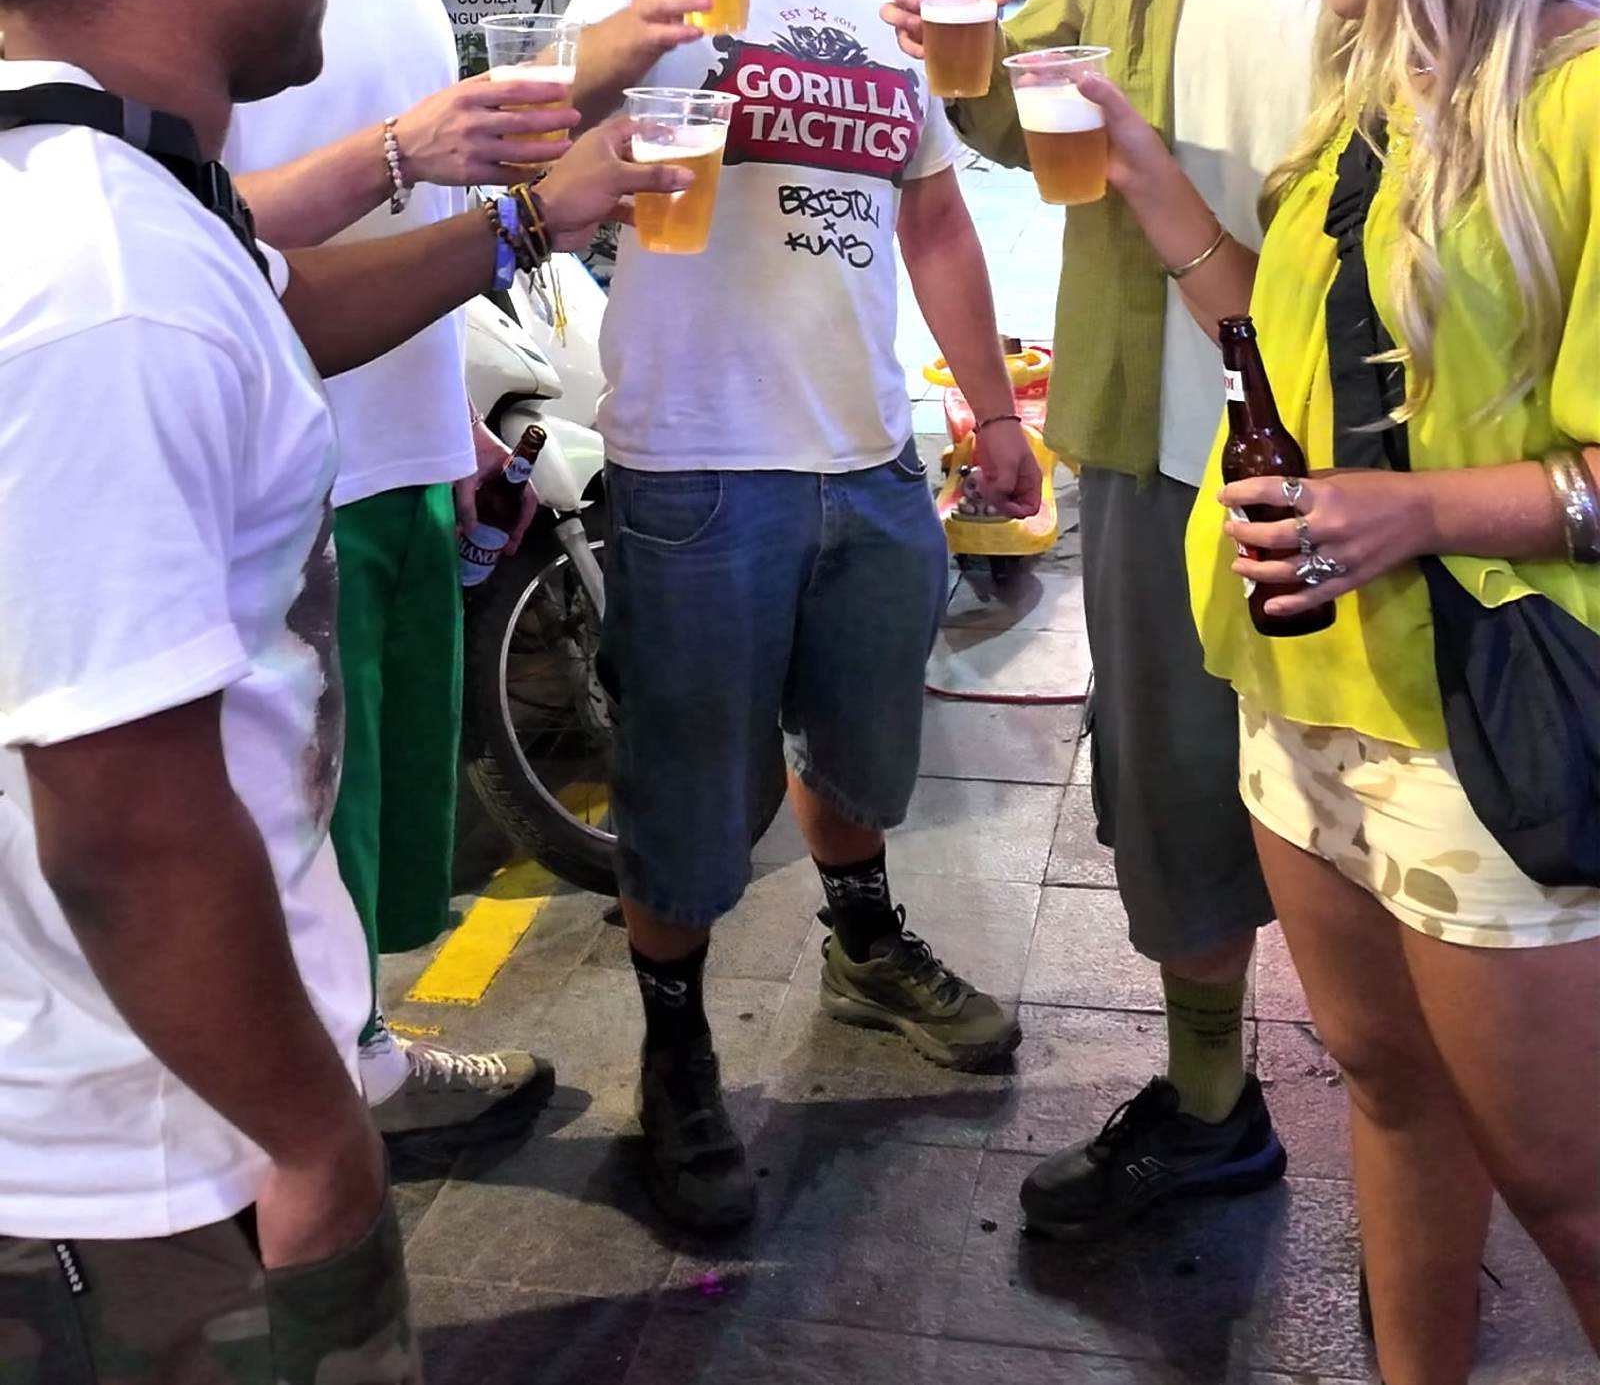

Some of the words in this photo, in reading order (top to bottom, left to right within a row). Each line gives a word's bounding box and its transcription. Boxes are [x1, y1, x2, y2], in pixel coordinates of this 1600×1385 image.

[780, 9, 801, 21] EST
[737, 64, 915, 123] GORILLA
[742, 105, 911, 162] TACTICS
